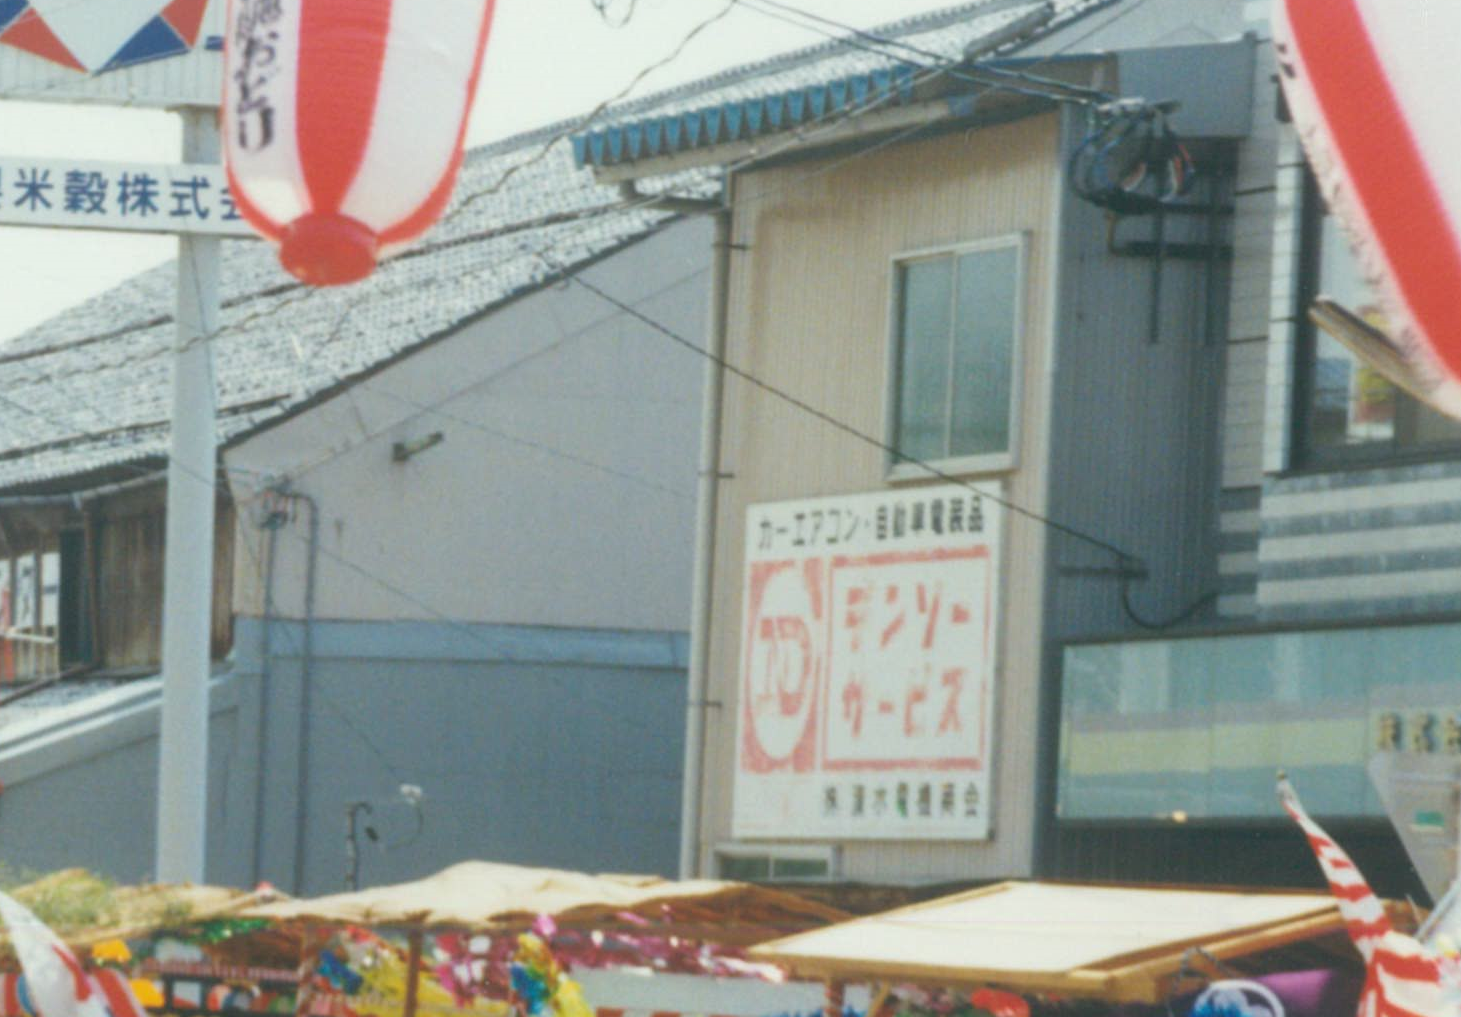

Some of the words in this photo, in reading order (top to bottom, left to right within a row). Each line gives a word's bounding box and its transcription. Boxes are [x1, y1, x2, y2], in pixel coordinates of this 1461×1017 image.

[845, 581, 971, 651] デンソー
[841, 661, 968, 738] サービス
